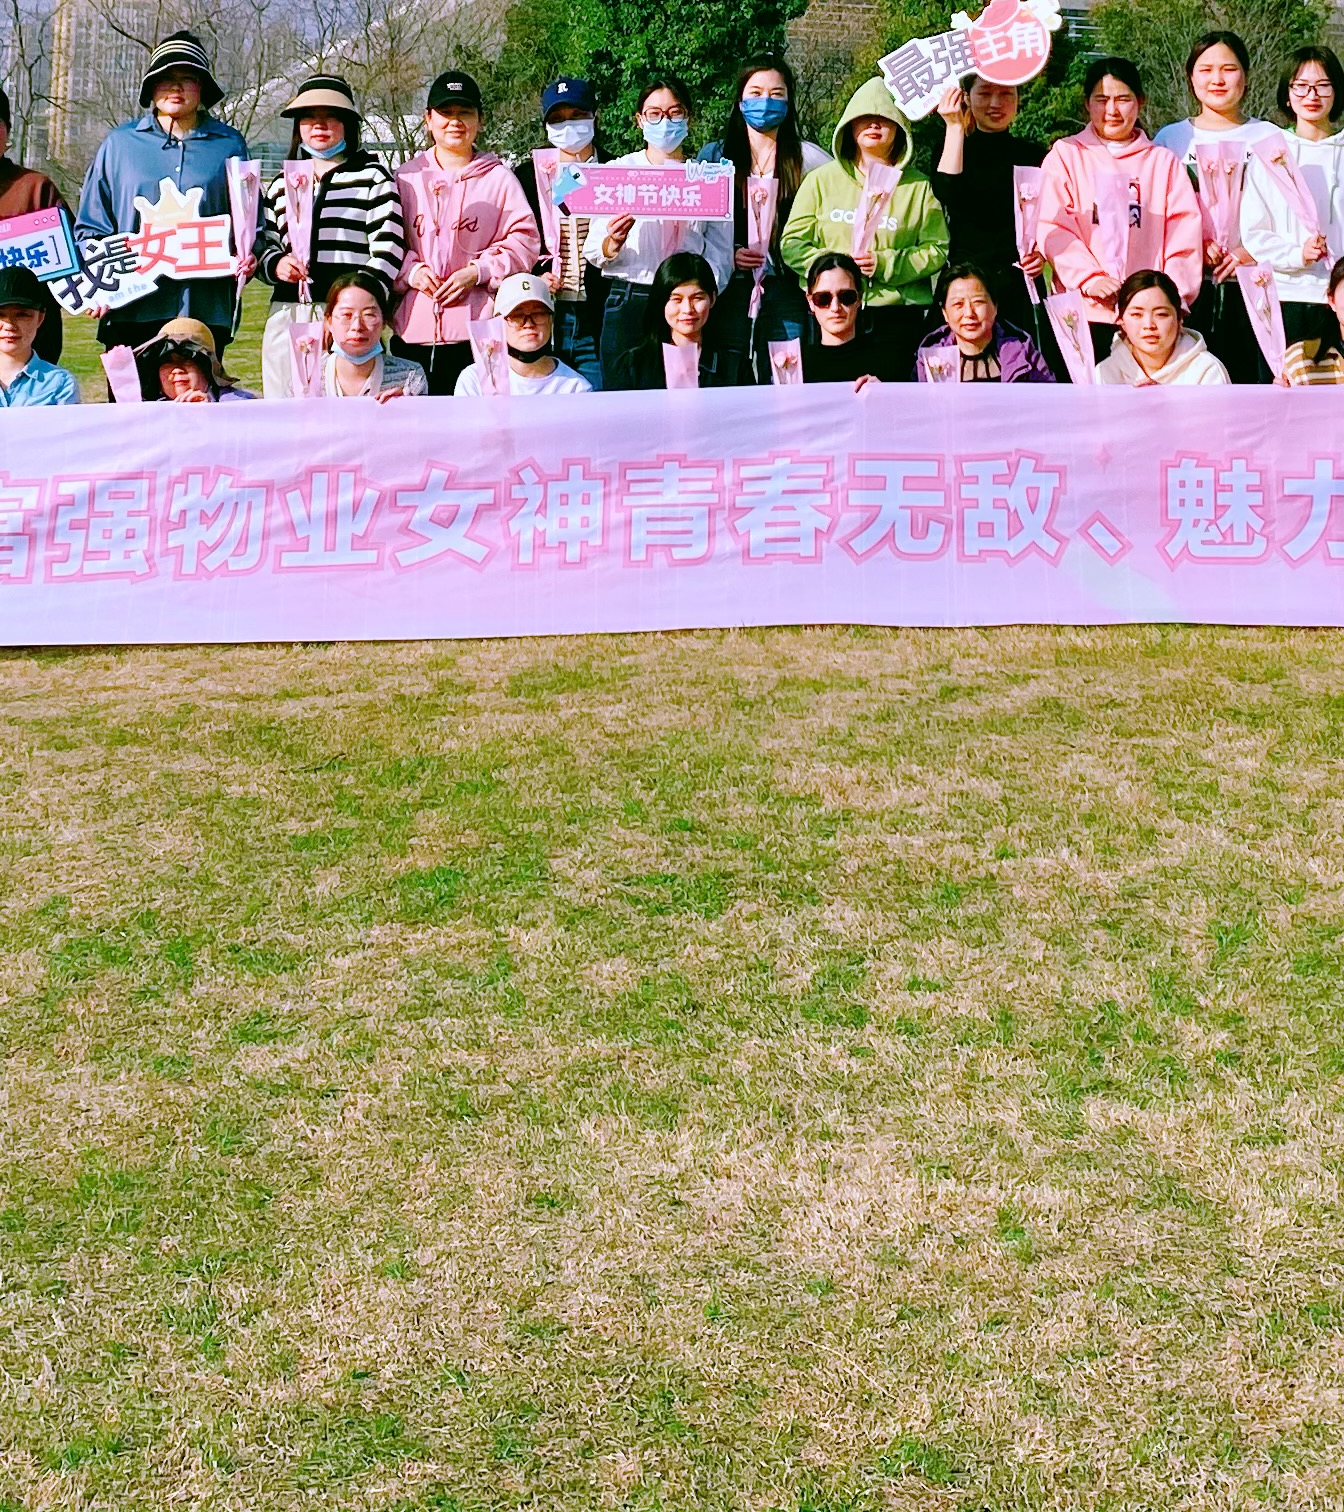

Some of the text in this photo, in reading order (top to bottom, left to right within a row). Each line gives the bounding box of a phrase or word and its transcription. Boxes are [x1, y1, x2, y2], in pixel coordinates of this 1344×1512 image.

[884, 21, 1045, 105] 最强主角
[593, 183, 702, 207] 女神节快乐
[829, 208, 899, 232] adas
[57, 219, 231, 311] 我是女王
[521, 281, 531, 291] C
